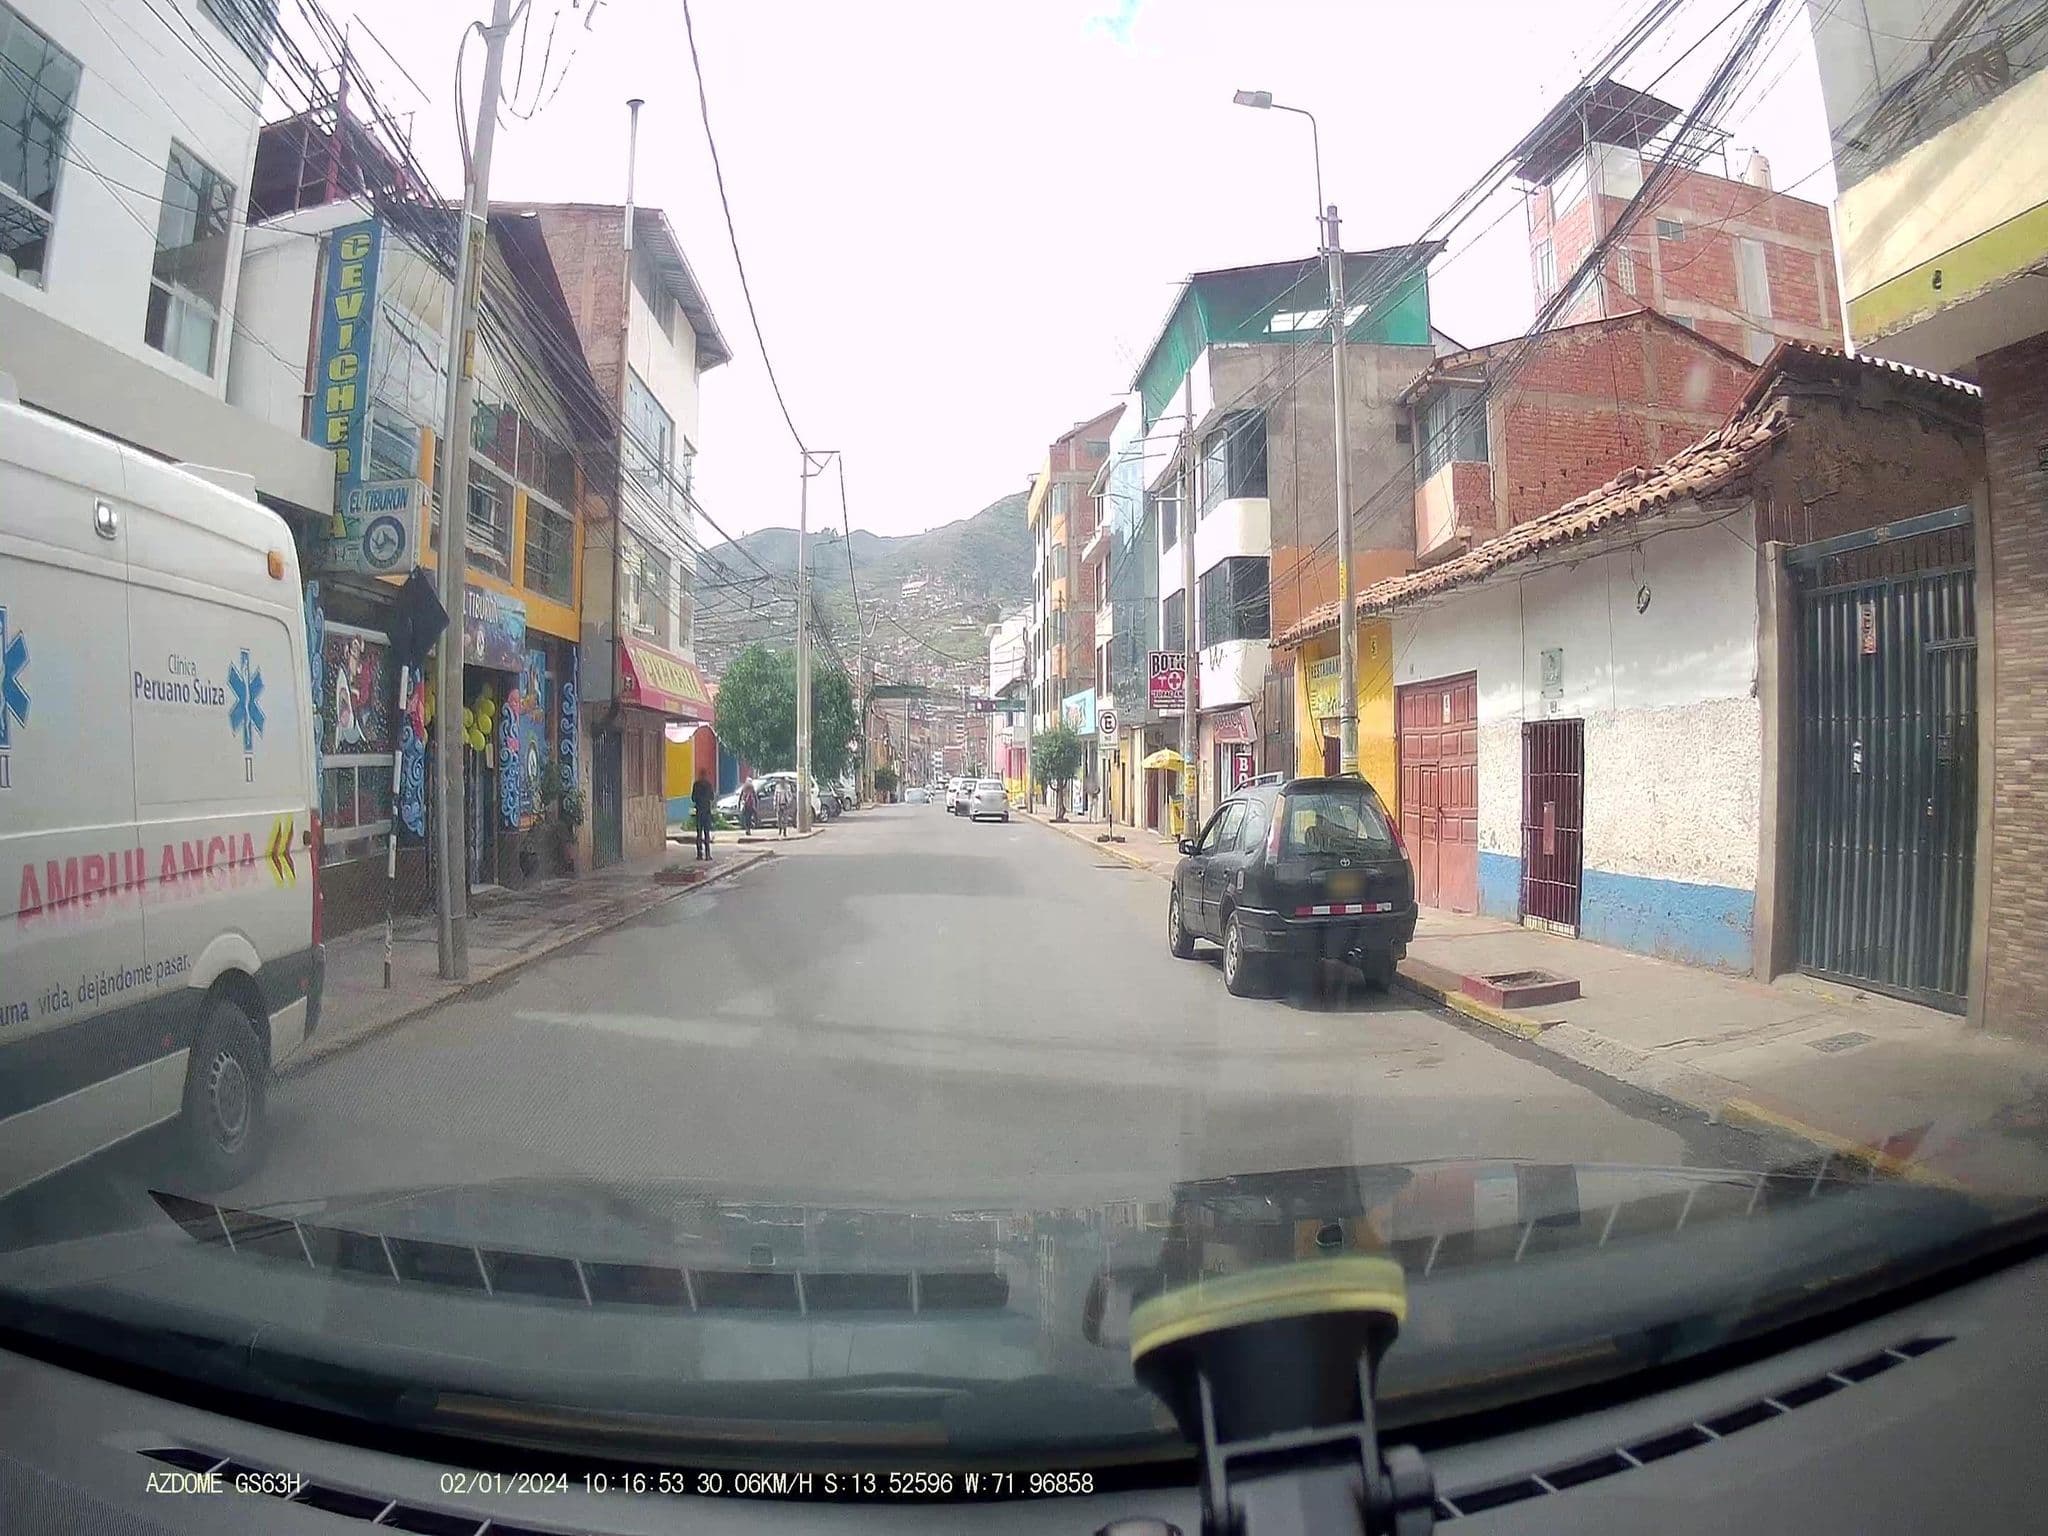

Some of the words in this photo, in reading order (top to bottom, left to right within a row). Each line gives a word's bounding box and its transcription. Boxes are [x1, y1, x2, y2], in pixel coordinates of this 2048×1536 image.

[349, 491, 361, 513] EL
[365, 488, 409, 512] TIBURON
[1151, 654, 1198, 677] BOTIC
[134, 670, 191, 703] Peruano
[193, 678, 226, 706] Suiza
[38, 981, 74, 1016] vida,
[78, 962, 153, 1005] dejándome
[156, 952, 191, 986] pasar.
